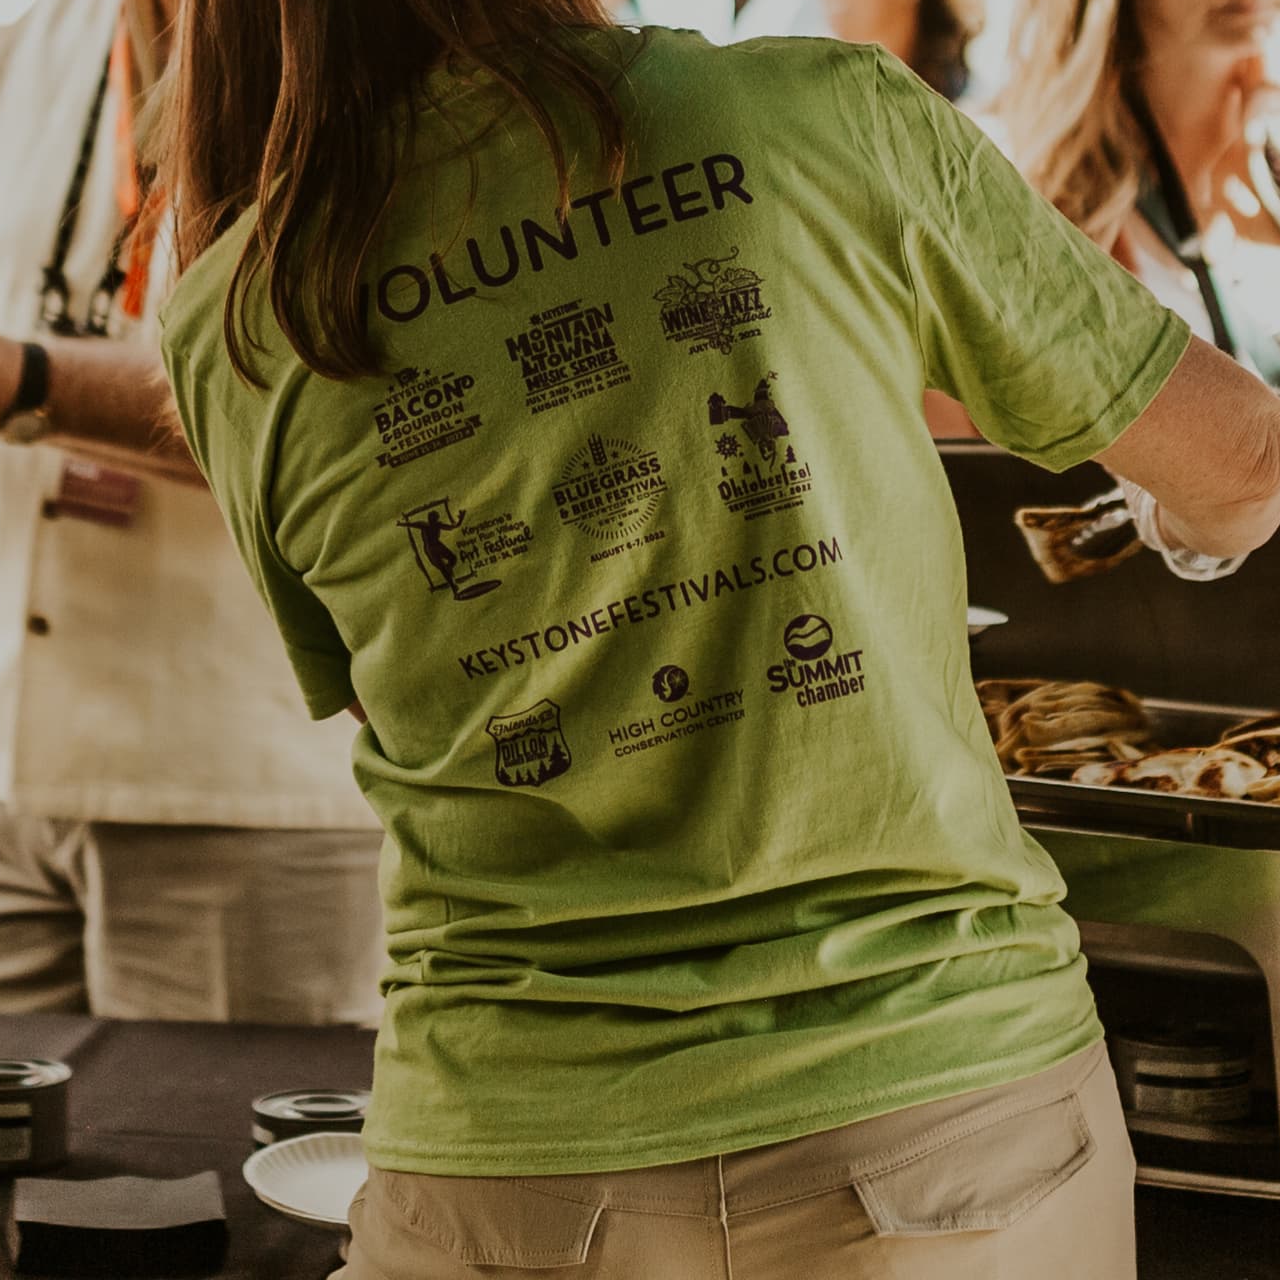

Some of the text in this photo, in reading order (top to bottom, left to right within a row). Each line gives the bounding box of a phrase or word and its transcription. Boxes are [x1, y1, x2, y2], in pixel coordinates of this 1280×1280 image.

[662, 300, 712, 333] WINE
[721, 287, 764, 318] JAZZ
[505, 302, 615, 362] MOUNTAIN
[525, 348, 619, 391] MUSIC SERIES
[375, 375, 475, 433] BACON
[386, 376, 440, 405] KEYSTONE
[526, 393, 547, 407] JULY
[531, 395, 570, 414] AUGUST
[398, 421, 454, 450] FESTIVAL
[553, 458, 661, 506] BLUEGRASS
[571, 496, 604, 516] BEER
[605, 476, 666, 502] FESTIVAL
[590, 544, 625, 562] AUGUST
[458, 537, 843, 680] KEYSTONEFESTIVALS.COM
[767, 650, 863, 693] SUMMIT
[796, 674, 864, 708] chamber
[493, 714, 539, 736] Friends
[608, 689, 744, 744] HIGH COUNTRY
[614, 709, 745, 757] CONSERVATION CENTER
[502, 735, 549, 760] DILLON
